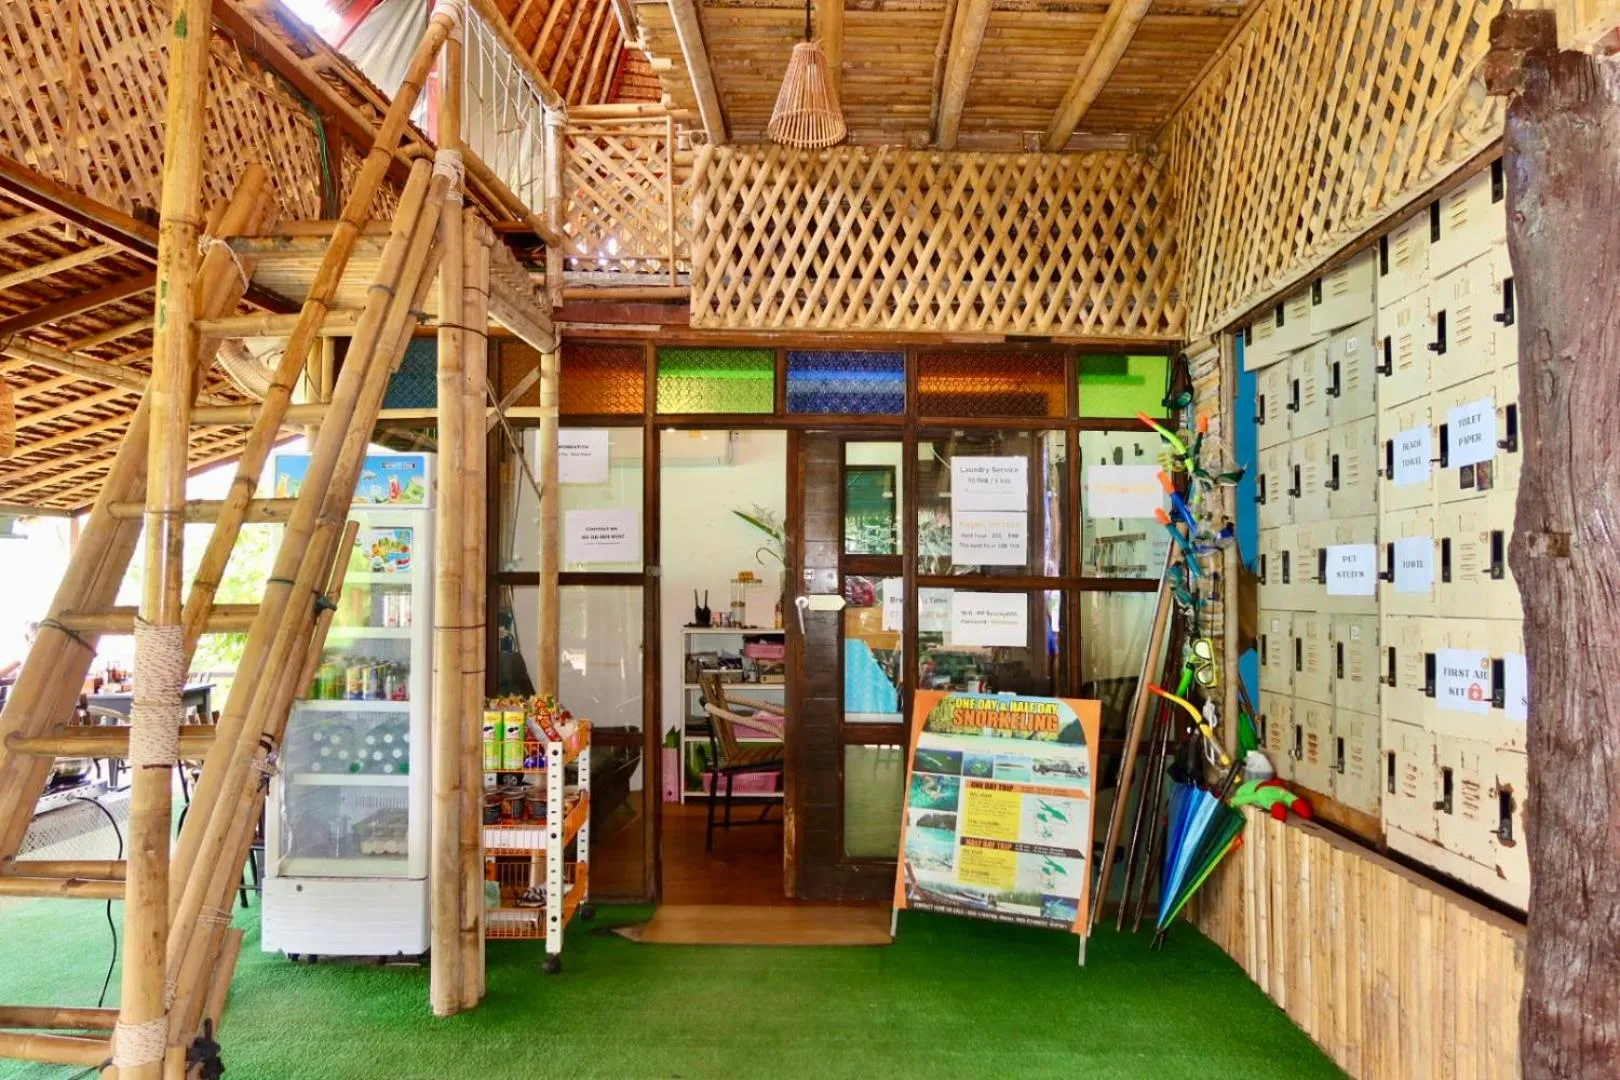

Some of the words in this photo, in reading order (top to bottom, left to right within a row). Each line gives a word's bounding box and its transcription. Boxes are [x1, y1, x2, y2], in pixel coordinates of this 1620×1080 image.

[1458, 414, 1482, 428] TOILET
[1458, 433, 1482, 446] PAPER
[1402, 456, 1422, 467] TOWEL
[960, 466, 989, 474] Laundry
[1342, 555, 1357, 563] PET
[1403, 560, 1425, 569] TOWEL
[1443, 667, 1470, 678] FIRST
[1448, 686, 1465, 696] KIT
[955, 698, 976, 709] ONE
[978, 699, 997, 711] DAY
[999, 703, 1007, 711] &
[1010, 701, 1035, 713] HALF
[1037, 703, 1059, 714] DAY
[953, 709, 1060, 732] SNORKELING
[999, 783, 1014, 792] TRIP
